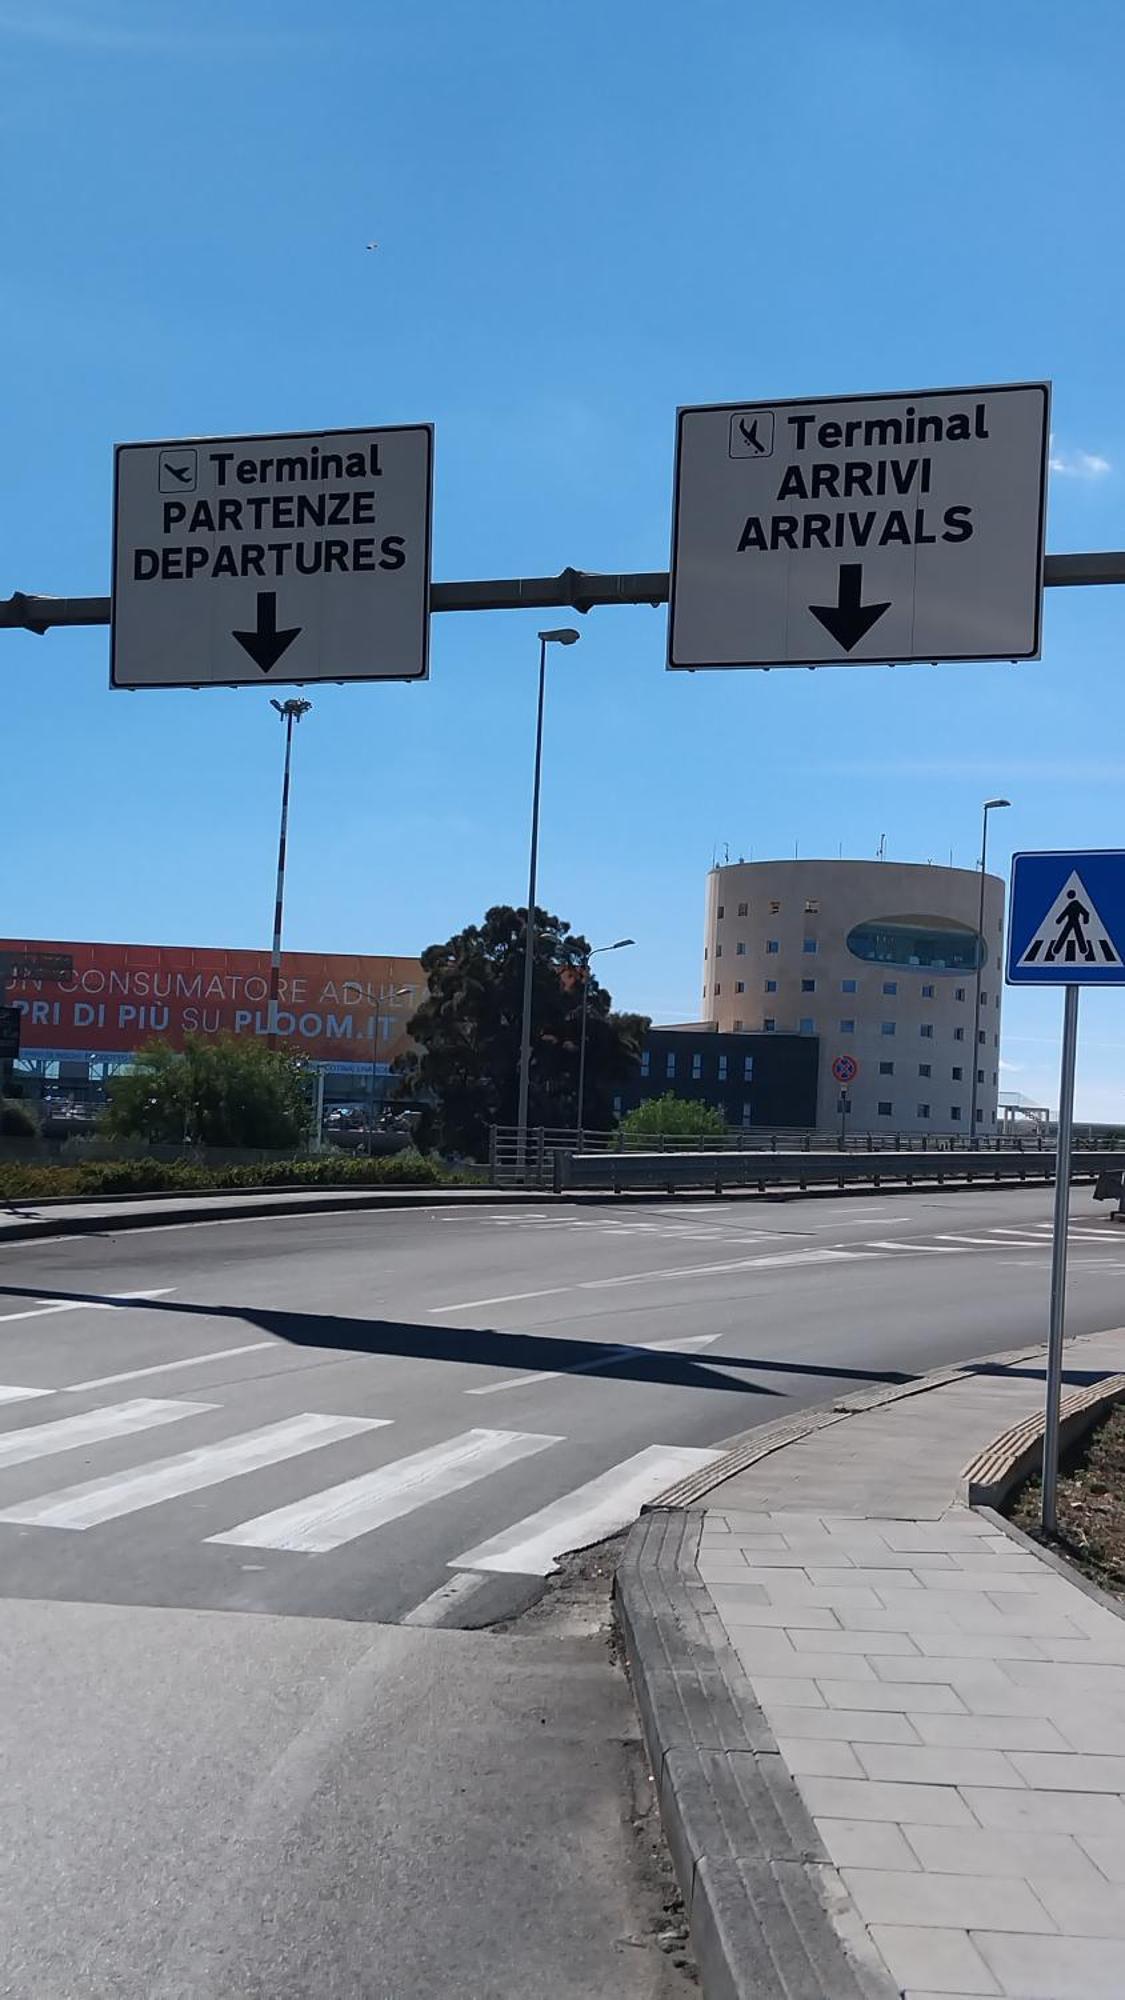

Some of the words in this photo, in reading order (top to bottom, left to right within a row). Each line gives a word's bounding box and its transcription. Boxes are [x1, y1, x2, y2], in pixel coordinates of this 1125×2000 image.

[788, 404, 989, 450] Terminal
[210, 444, 383, 486] Terminal
[776, 458, 931, 501] ARRIVI
[162, 491, 376, 534] PARTENZE
[736, 505, 974, 553] ARRIVALS
[133, 536, 406, 581] DEPARTURES
[57, 969, 307, 1003] CONSUMATORE
[74, 1002, 105, 1028] DI
[118, 1001, 170, 1031] PIÙ
[181, 1007, 220, 1033] SU
[234, 1010, 396, 1041] PLOOM.IT
